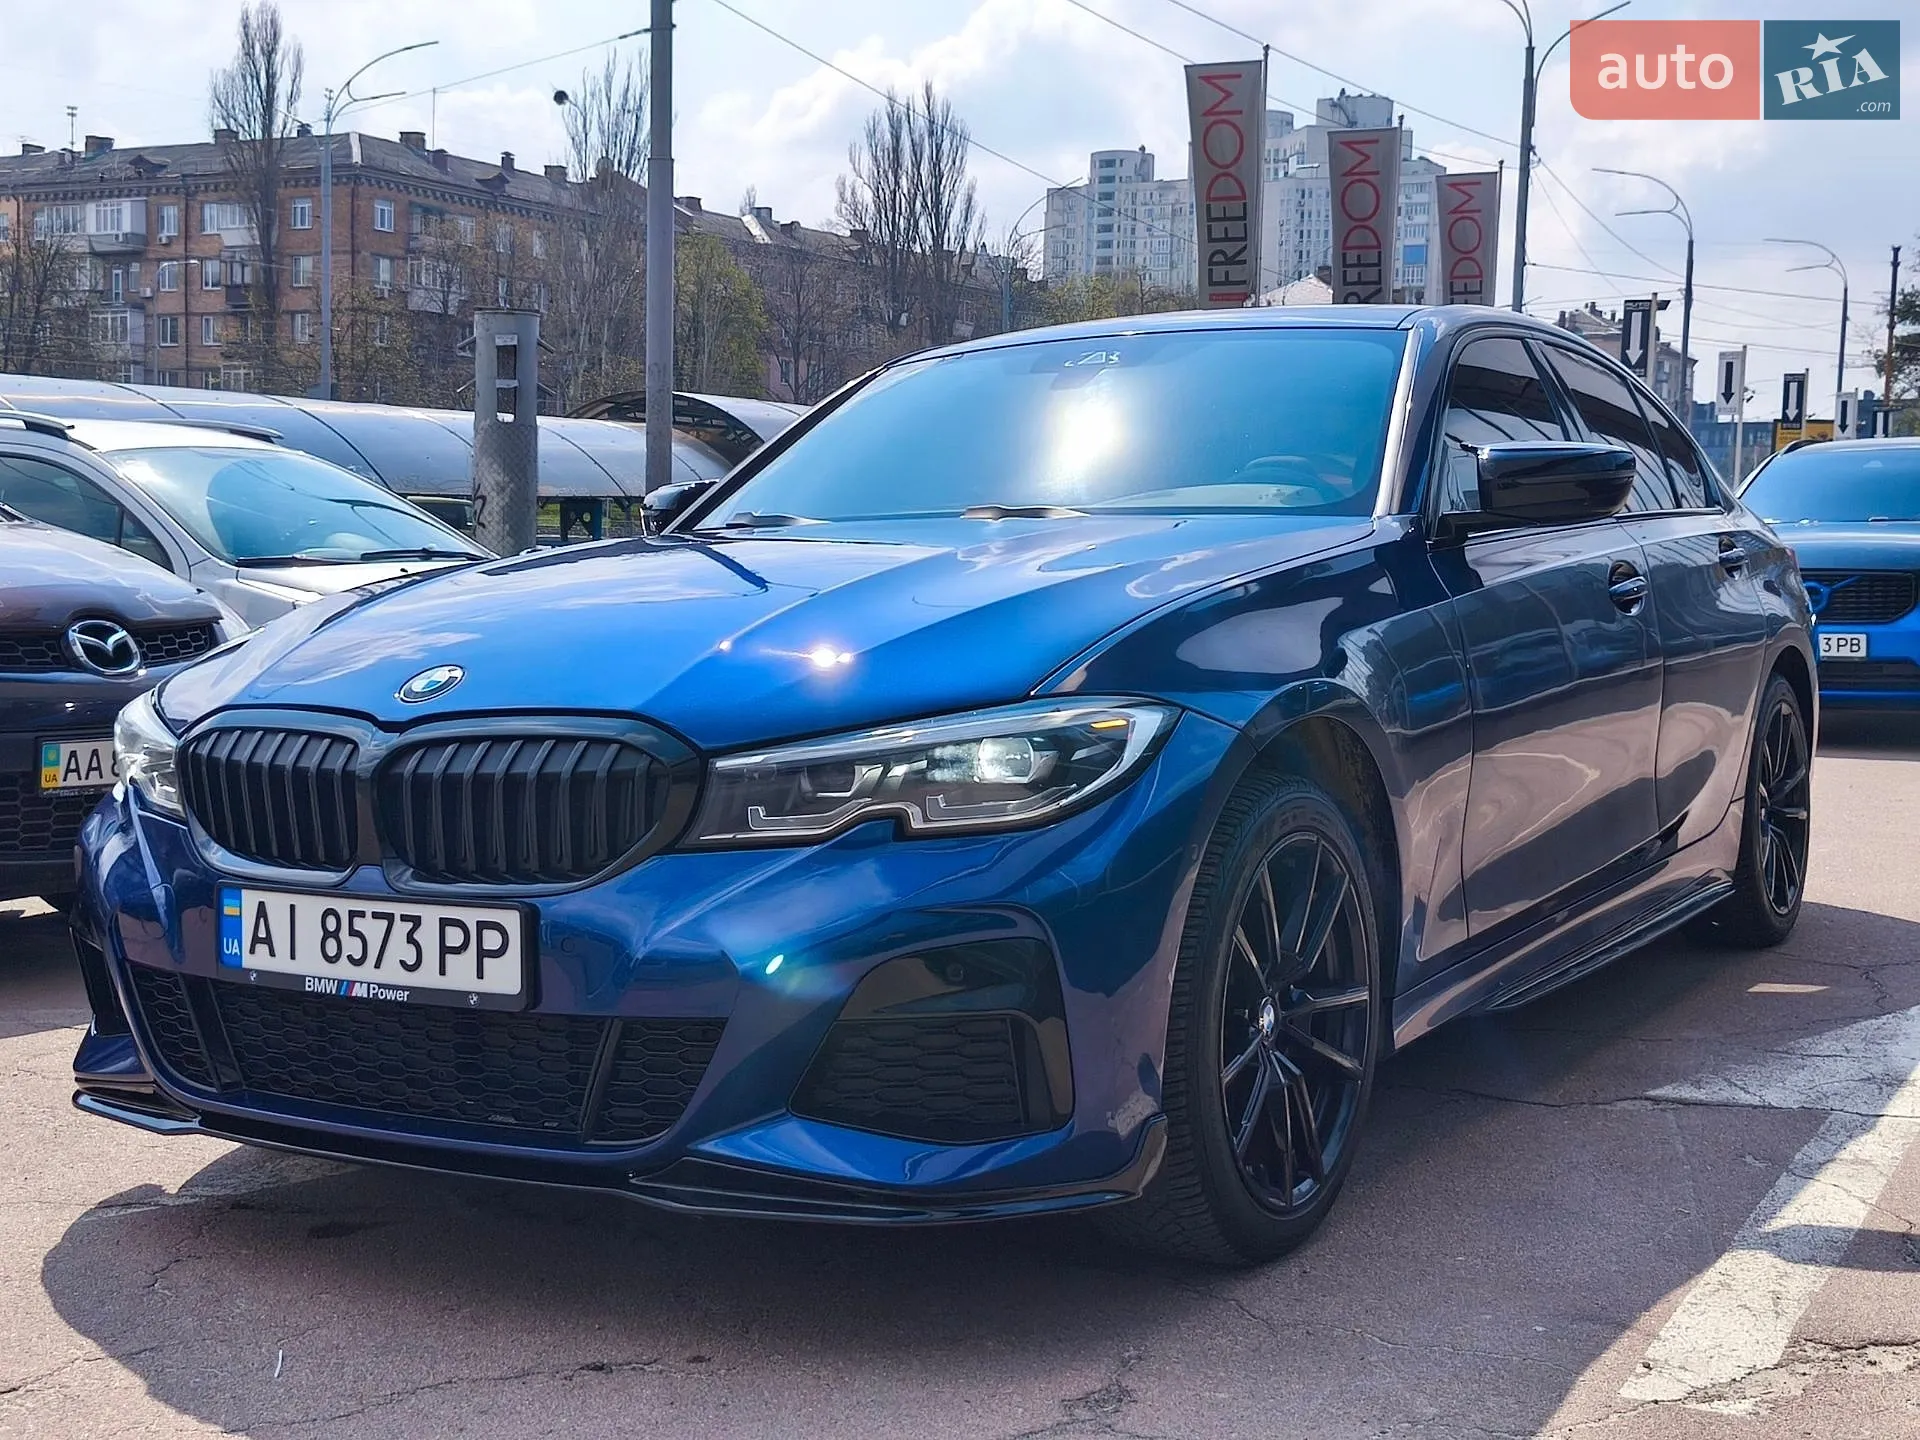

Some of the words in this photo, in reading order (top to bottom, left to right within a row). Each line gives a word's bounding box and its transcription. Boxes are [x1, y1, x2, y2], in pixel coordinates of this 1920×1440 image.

[1198, 73, 1249, 287] FREEDOM
[1836, 637, 1861, 653] PB
[62, 748, 103, 782] AA
[44, 773, 58, 783] UA
[223, 938, 241, 956] UA
[248, 900, 296, 961] AI
[320, 907, 423, 973] 8573
[438, 916, 510, 980] PP
[304, 977, 338, 995] BMW
